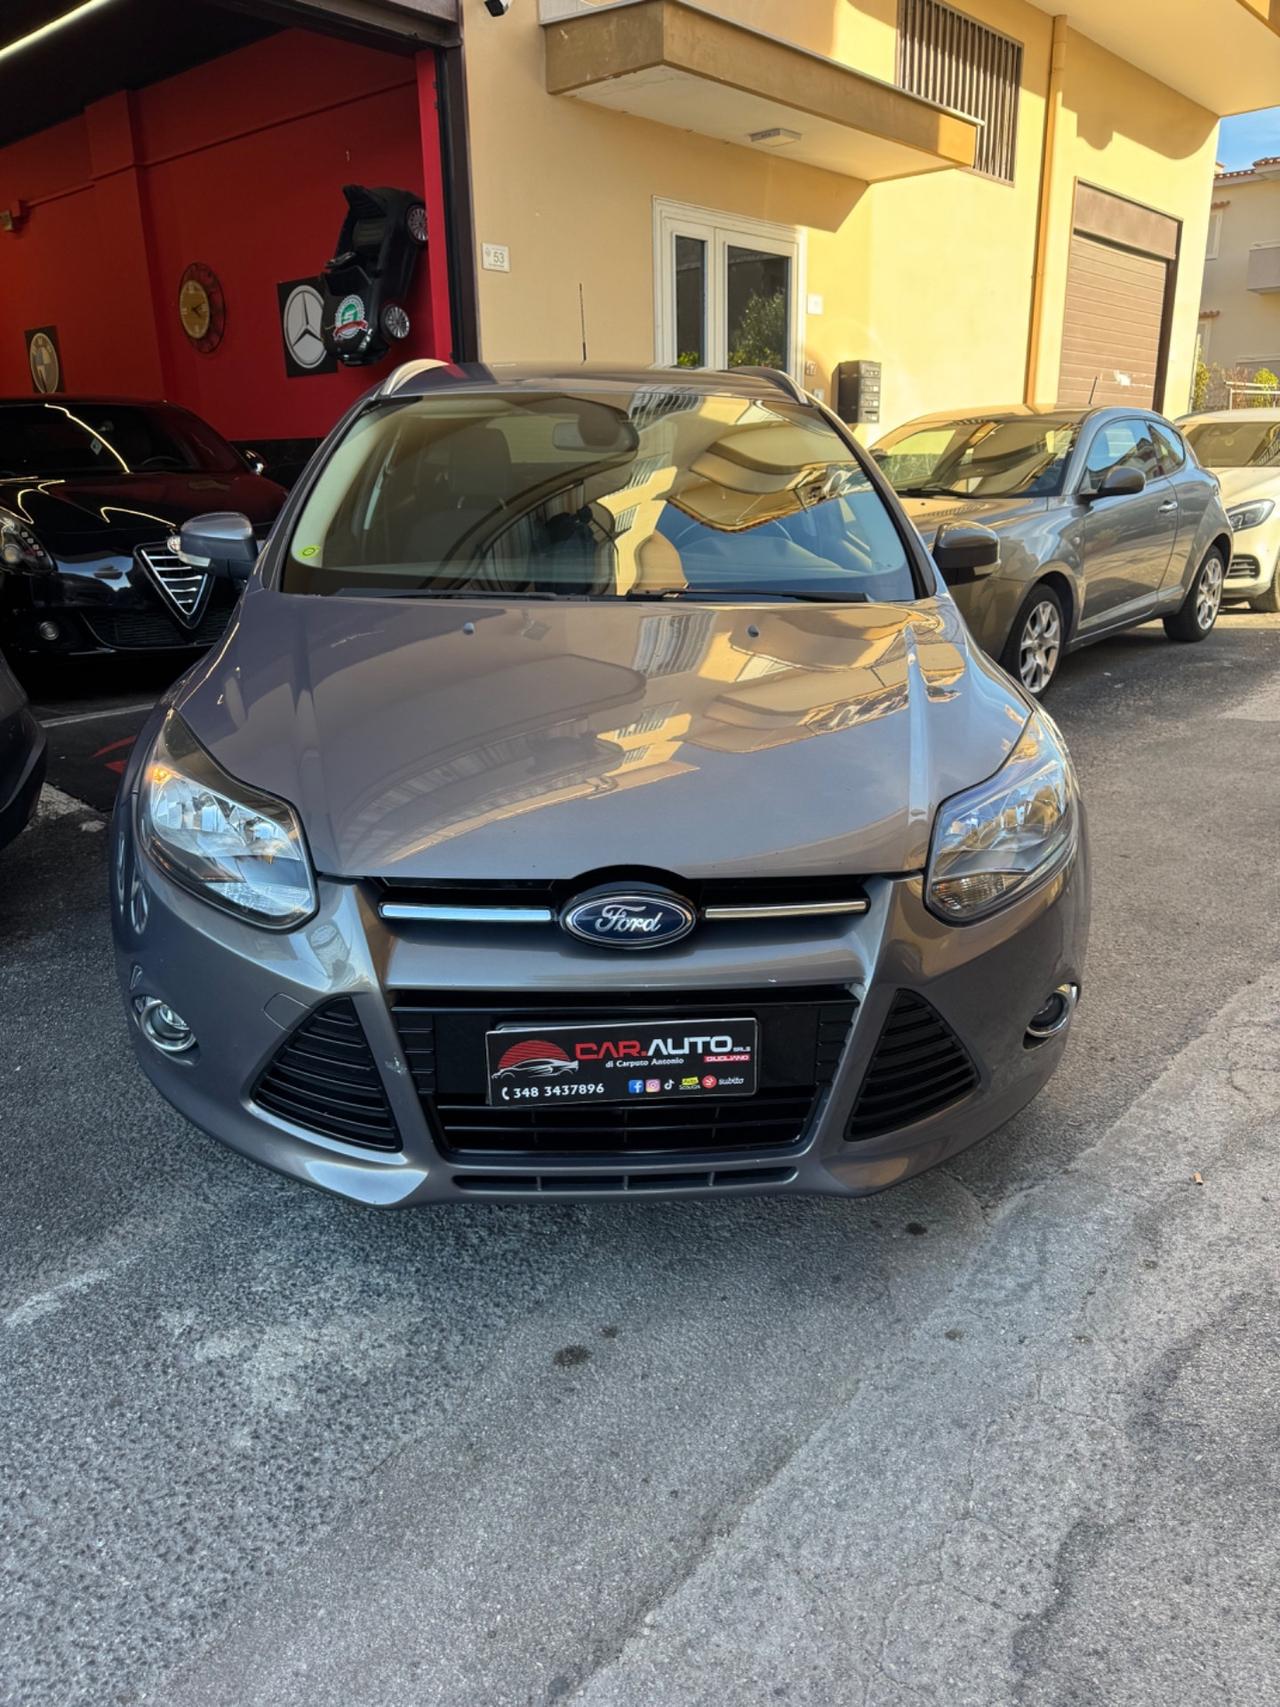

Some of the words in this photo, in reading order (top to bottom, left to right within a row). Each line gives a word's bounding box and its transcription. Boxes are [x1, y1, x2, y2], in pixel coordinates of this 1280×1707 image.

[493, 250, 505, 265] 53
[594, 904, 663, 932] Ford
[651, 1057, 684, 1066] Antonio
[513, 1086, 539, 1099] 348
[544, 1083, 604, 1097] 3437896
